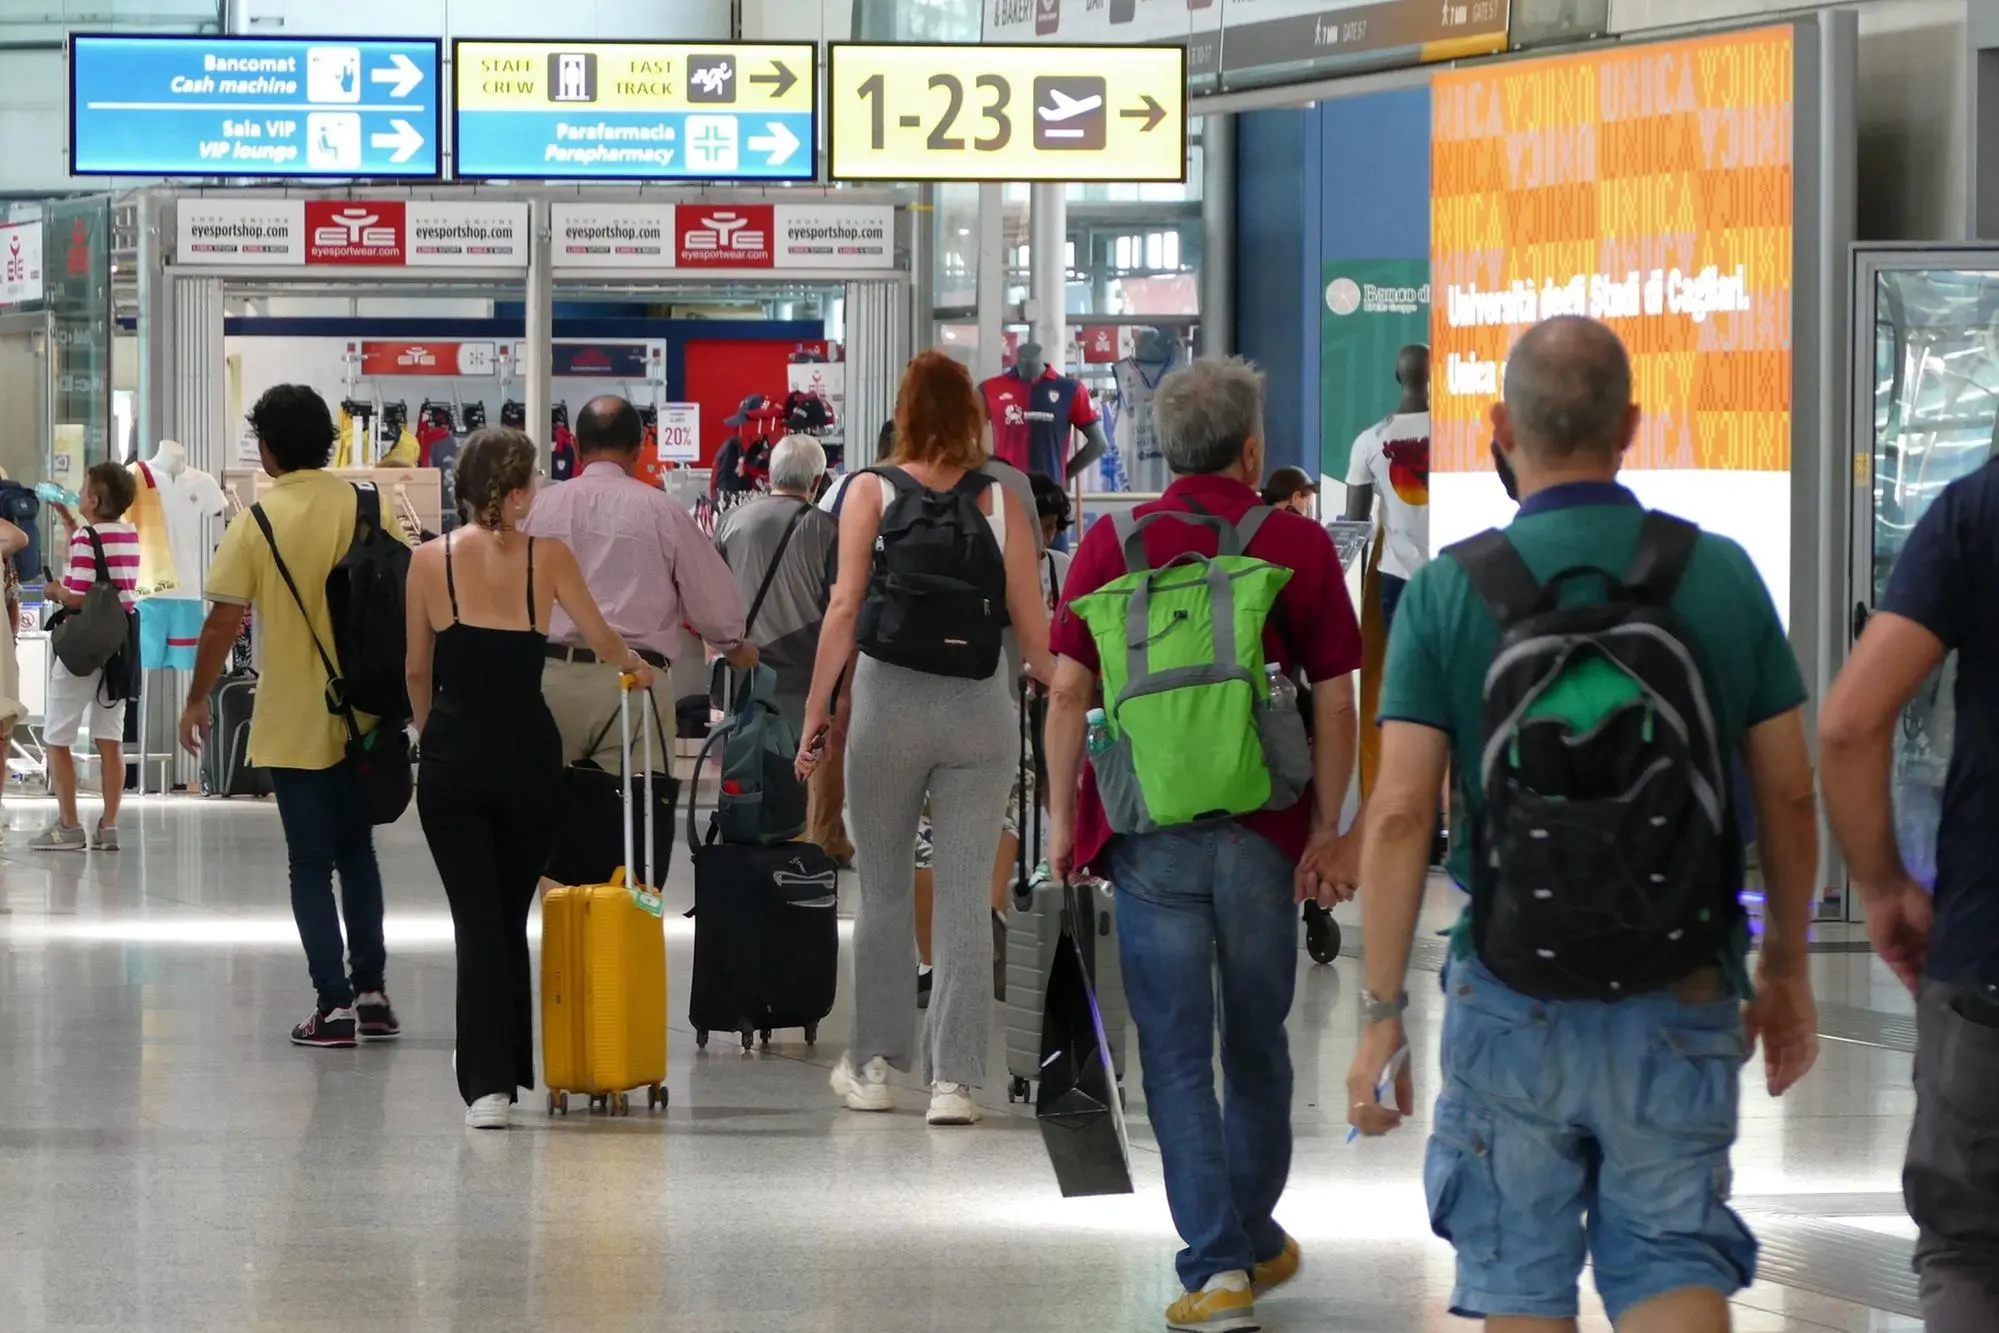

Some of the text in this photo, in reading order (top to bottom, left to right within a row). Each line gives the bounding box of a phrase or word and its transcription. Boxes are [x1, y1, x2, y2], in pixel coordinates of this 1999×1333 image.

[204, 54, 297, 73] Bancomat
[481, 59, 534, 72] STAFF
[630, 60, 673, 74] FAST
[170, 76, 297, 94] Cash machine
[482, 80, 535, 94] CREW
[615, 82, 673, 95] TRACK
[1601, 50, 1697, 122] UNICA
[857, 73, 1012, 151] 1-23
[223, 120, 297, 138] Sala VIP
[556, 123, 675, 142] Parafarmacia
[199, 141, 298, 162] VIP lounge
[545, 144, 674, 166] Parapharmacy
[1601, 112, 1697, 180] UNICA
[1601, 171, 1697, 238] UNICA
[191, 224, 288, 239] eyesportshop.com
[416, 226, 512, 240] eyesportshop.com
[565, 226, 660, 241] eyesportshop.com
[788, 226, 883, 241] eyesportshop.com
[311, 247, 399, 257] eyesportwear.com
[681, 250, 768, 261] eyesportwear.com
[1363, 284, 1417, 304] Banco
[1447, 263, 1750, 327] Università degli Studi di Cagliari.
[1447, 351, 1497, 396] Unica
[665, 427, 692, 446] 20%
